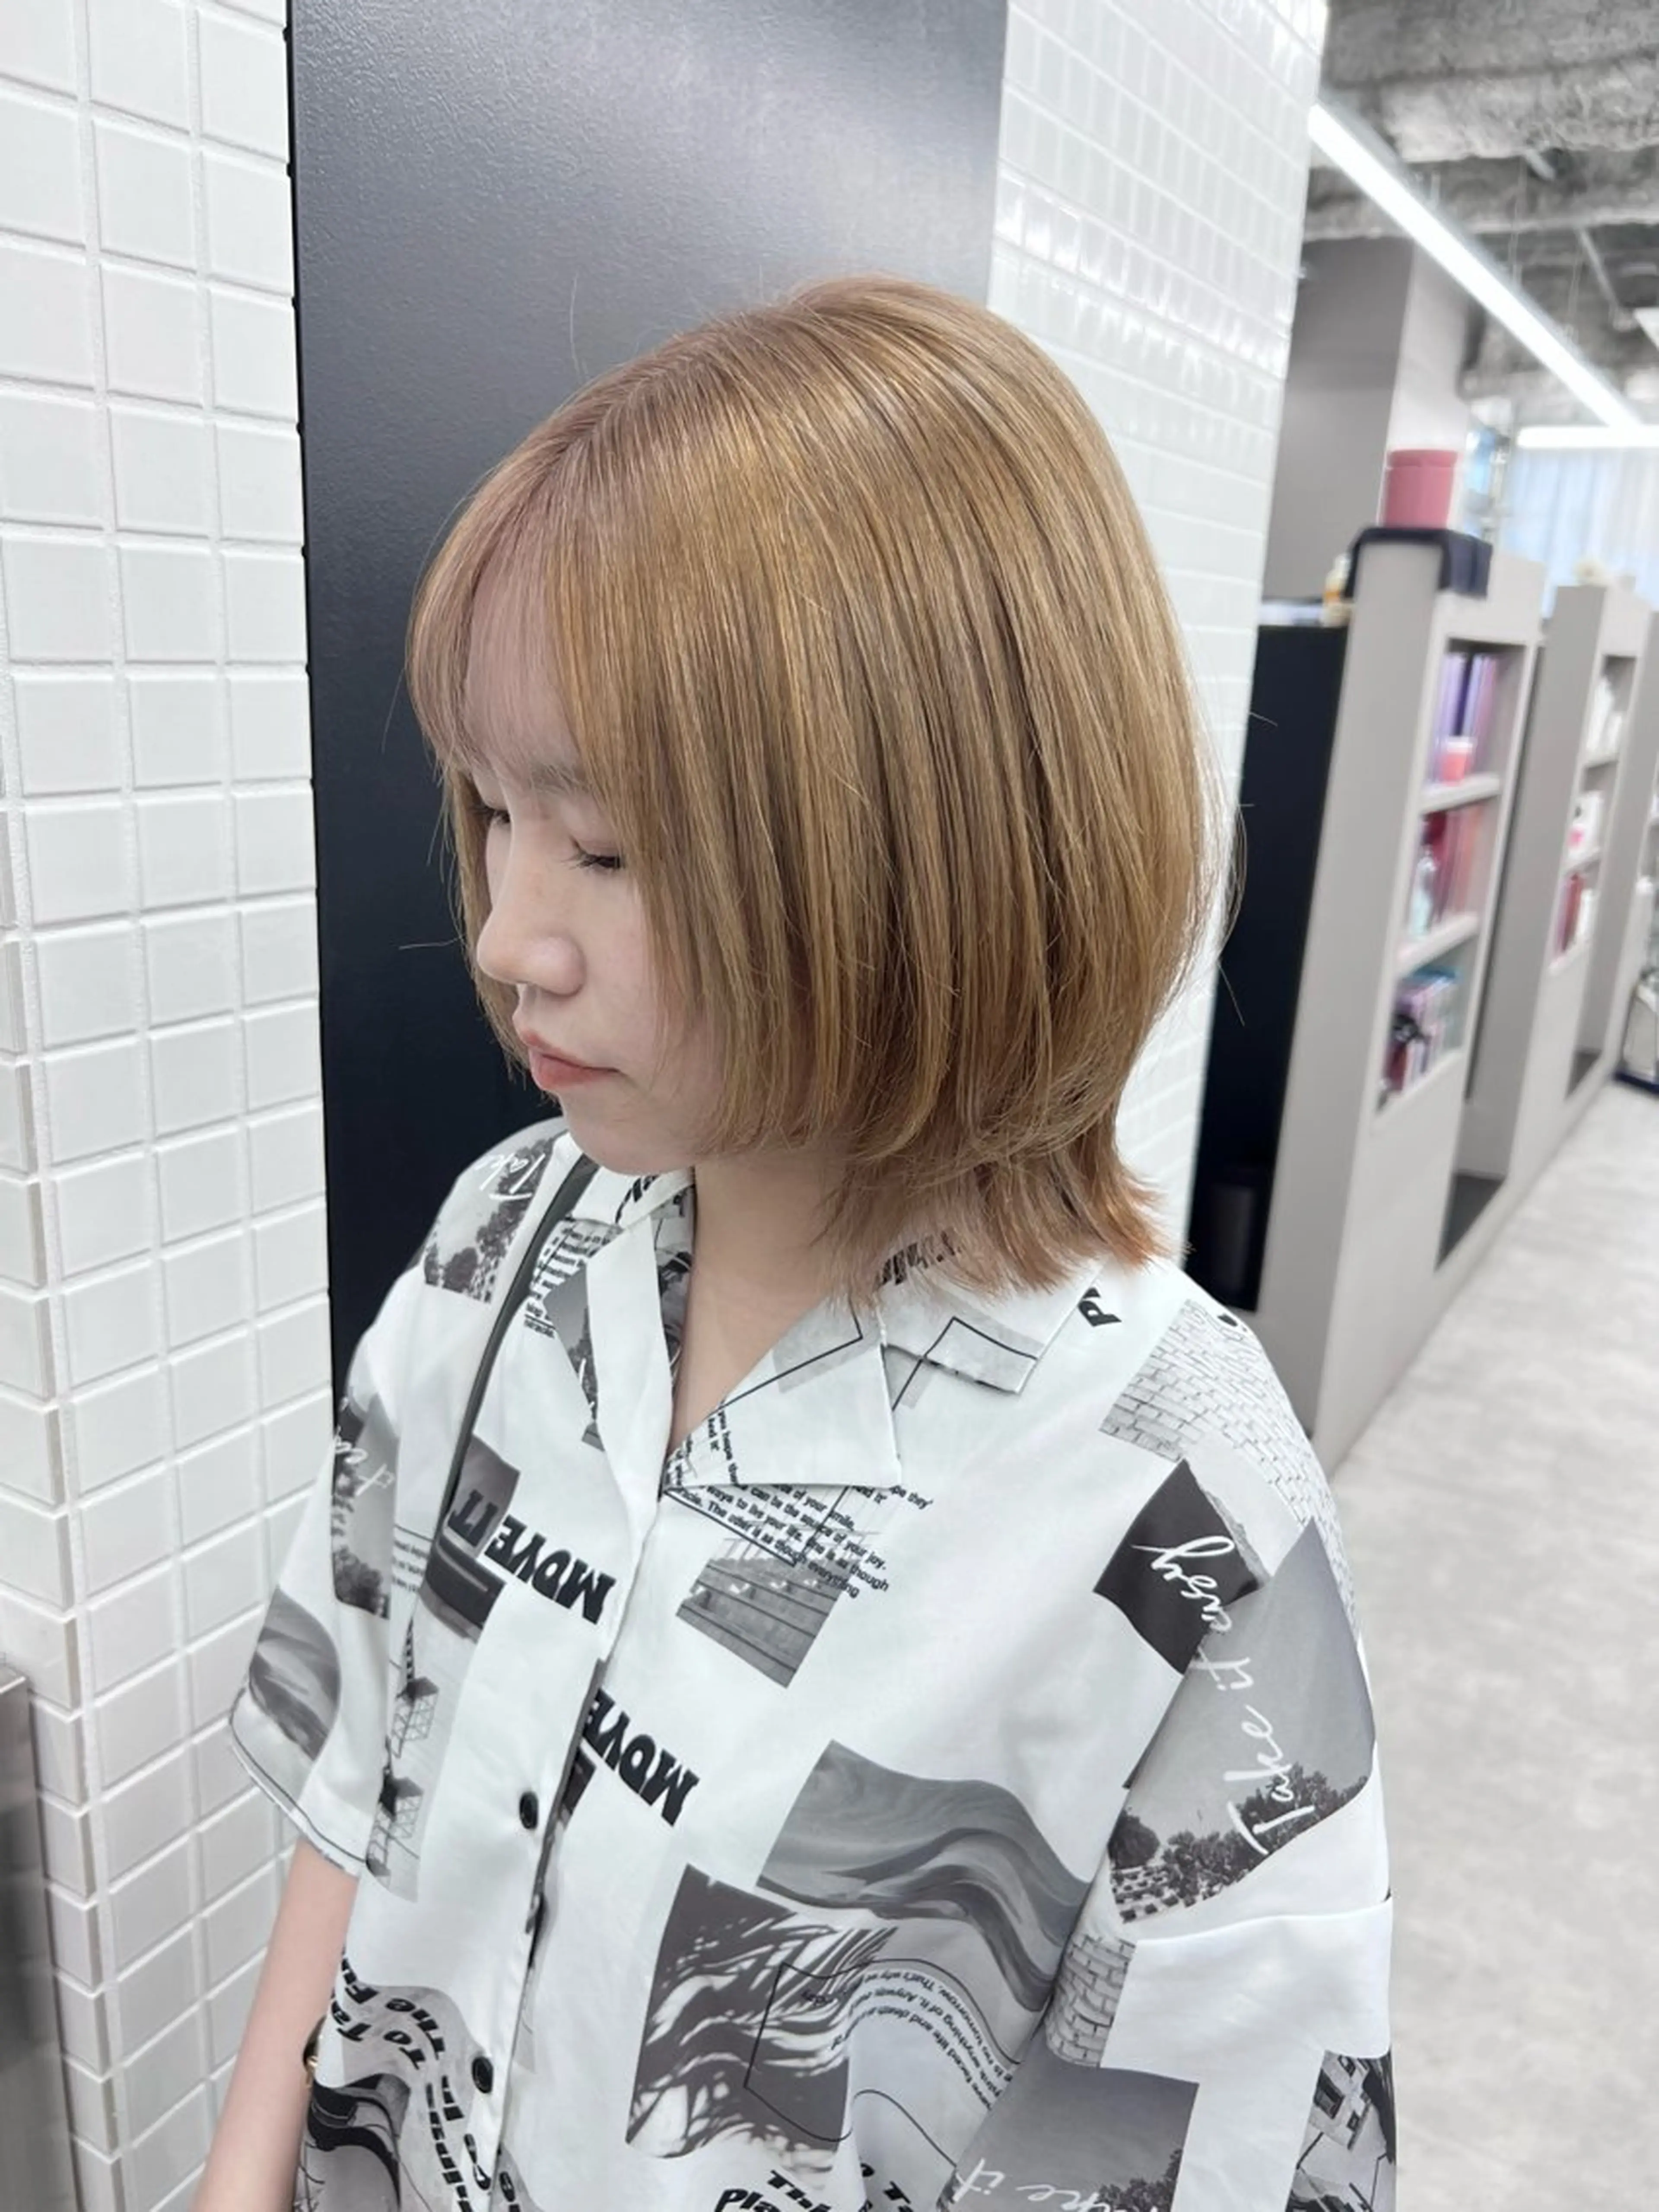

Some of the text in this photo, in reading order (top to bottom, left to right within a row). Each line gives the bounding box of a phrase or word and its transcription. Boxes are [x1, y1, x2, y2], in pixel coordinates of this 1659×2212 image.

[751, 1487, 770, 1501] can
[784, 1503, 799, 1517] the
[844, 1540, 868, 1557] your
[803, 1495, 828, 1511] your
[484, 1515, 616, 1625] MOVE
[709, 1501, 728, 1517] The
[808, 1562, 860, 1599] everything
[766, 1515, 787, 1530] your
[851, 1564, 888, 1592] though
[1193, 1643, 1254, 1692] it
[582, 1688, 699, 1826] MOVE
[1224, 1705, 1315, 1855] Take
